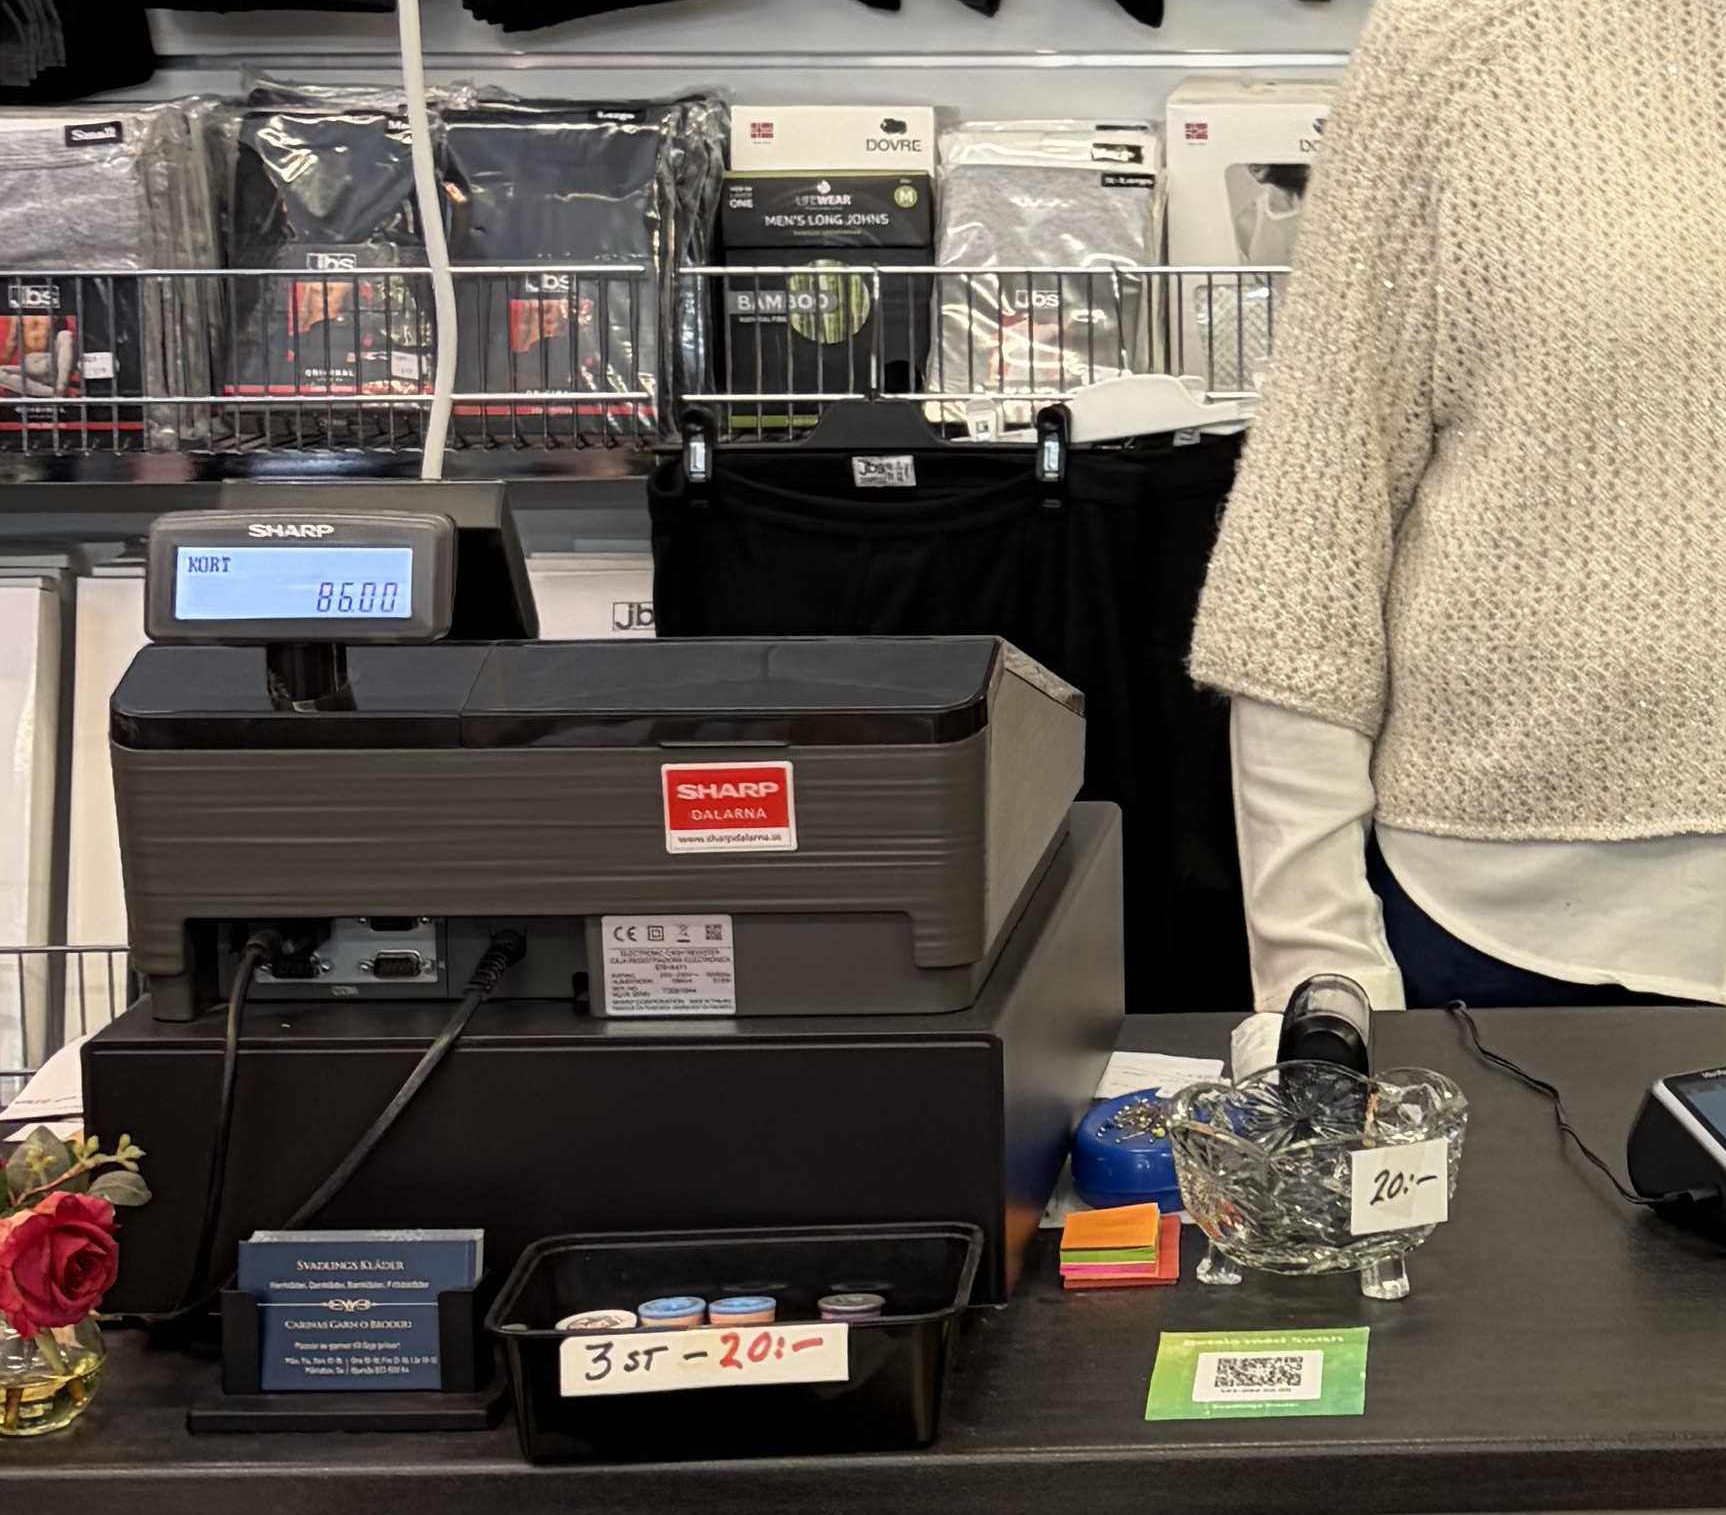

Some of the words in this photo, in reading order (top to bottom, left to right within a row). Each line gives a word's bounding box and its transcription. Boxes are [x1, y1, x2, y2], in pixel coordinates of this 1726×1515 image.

[866, 138, 923, 153] DOVRE
[899, 188, 913, 203] M
[765, 214, 806, 227] MEN'S
[808, 214, 844, 226] LONG
[845, 213, 890, 226] JOHNS
[248, 524, 335, 538] SHARP
[187, 556, 232, 573] KORT
[614, 601, 655, 631] jb
[676, 781, 780, 800] SHARP
[691, 807, 768, 821] DALARNA
[1369, 1168, 1439, 1206] 20:-
[584, 1341, 614, 1381] 3
[622, 1345, 669, 1373] ST
[719, 1331, 824, 1370] 20:-
